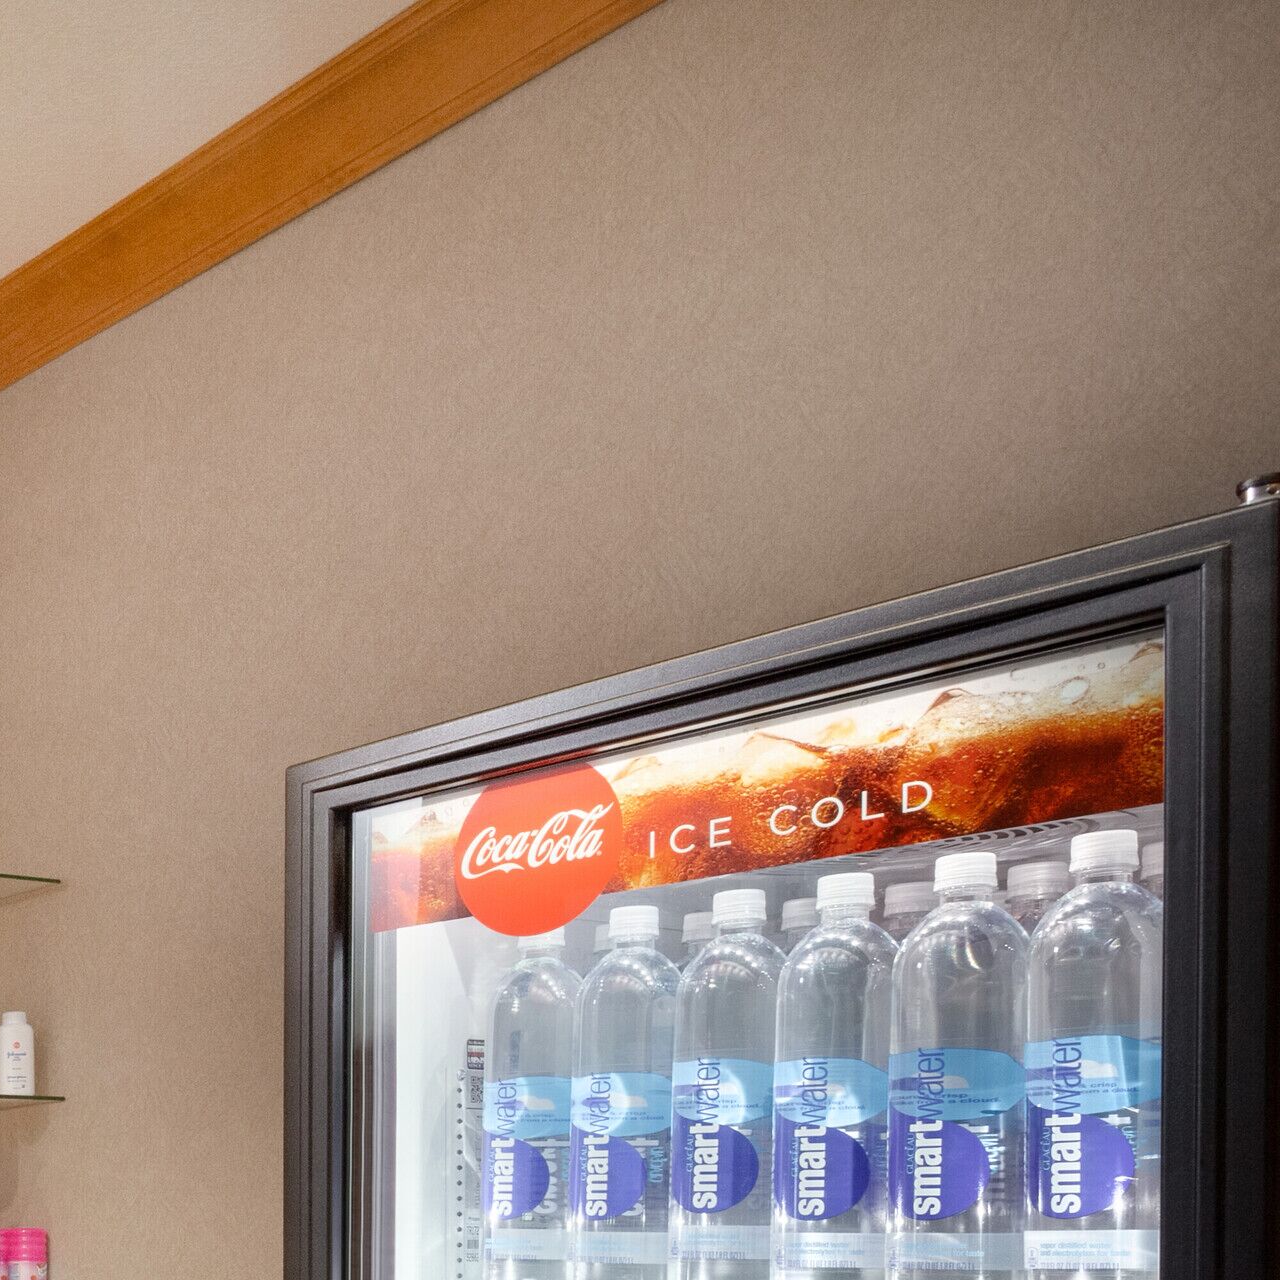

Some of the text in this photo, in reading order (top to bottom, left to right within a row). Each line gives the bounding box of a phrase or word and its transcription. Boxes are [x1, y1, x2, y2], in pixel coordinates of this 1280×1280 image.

[461, 802, 614, 880] Coca-Cola
[649, 780, 934, 858] ICE COLD
